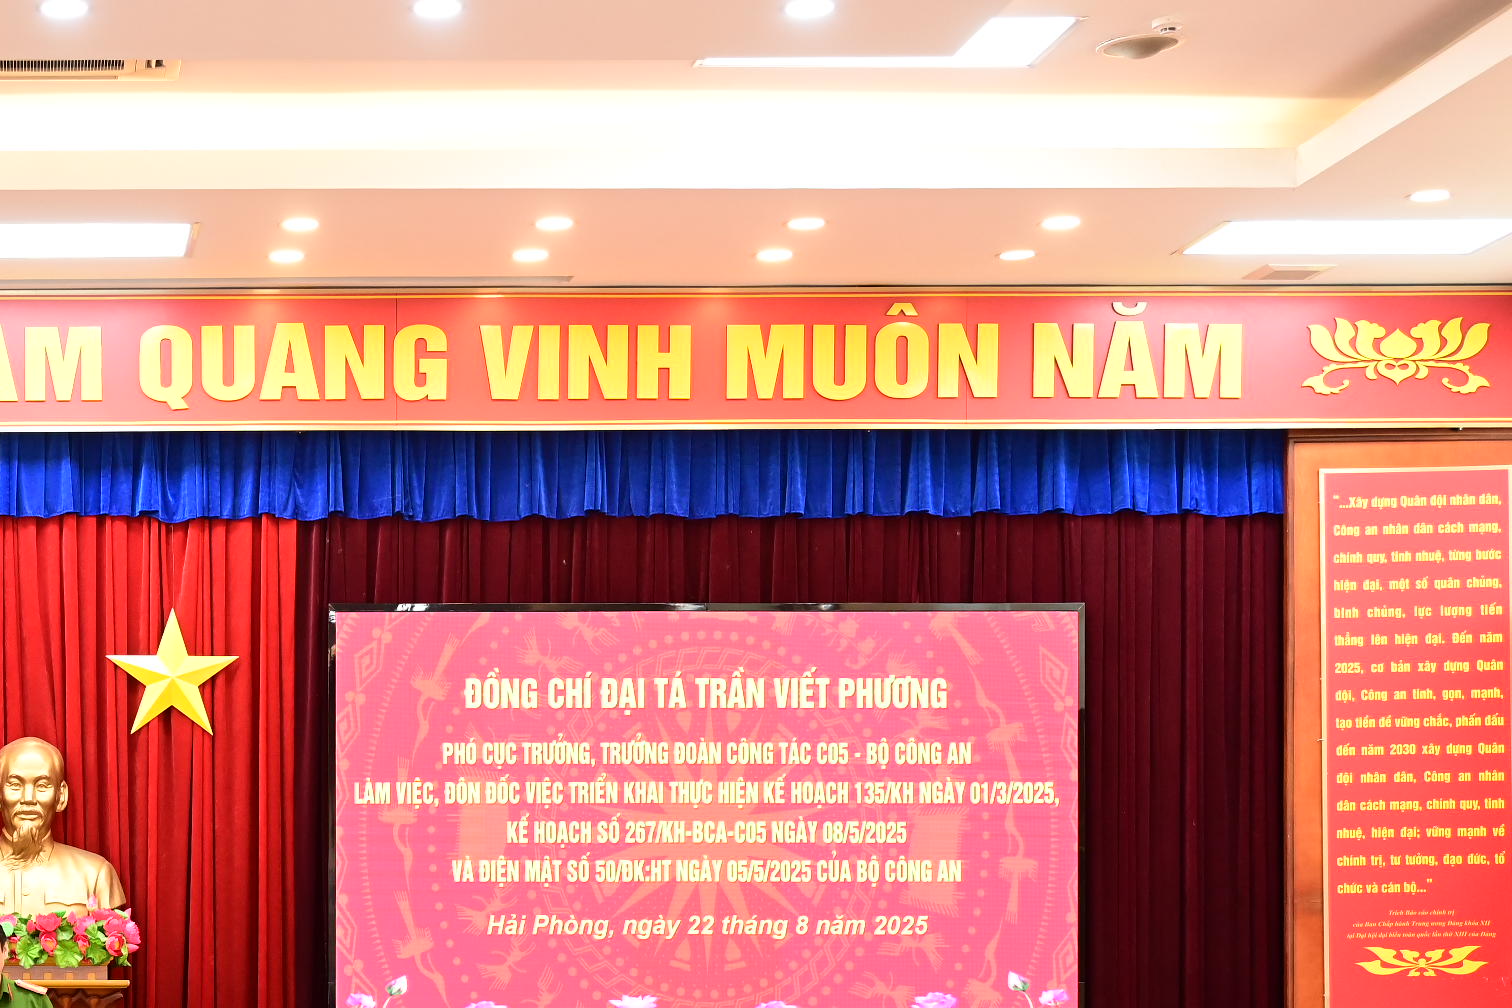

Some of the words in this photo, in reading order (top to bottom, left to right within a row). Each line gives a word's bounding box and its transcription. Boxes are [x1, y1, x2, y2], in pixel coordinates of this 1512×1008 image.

[139, 322, 448, 410] QUANG
[479, 324, 691, 400] VINH
[726, 302, 999, 400] MUÔN
[1032, 301, 1243, 399] NĂM
[464, 668, 537, 709] ĐỒNG
[548, 672, 592, 708] CHÍ
[600, 678, 644, 715] ĐẠI
[654, 671, 686, 708] TÁ
[695, 667, 764, 708] TRẦN
[774, 667, 830, 708] VIẾT
[839, 675, 947, 708] PHƯƠNG
[443, 738, 476, 764] PHÓ
[482, 742, 516, 769] CỤC
[522, 733, 595, 767] TRƯỞNG,
[600, 733, 668, 764] TRƯỞNG
[674, 738, 721, 764] ĐOÀN
[727, 738, 773, 764] CÔNG
[779, 738, 811, 764] TÁC
[817, 742, 848, 764] C05
[866, 738, 889, 769] BỘ
[895, 738, 941, 764] CÔNG
[947, 742, 971, 764] AN
[355, 778, 390, 804] LÀM
[396, 778, 438, 809] VIỆC,
[445, 777, 480, 804] ĐÔN
[485, 774, 520, 804] ĐỐC
[526, 777, 563, 808] VIỆC
[569, 773, 617, 803] TRIỂN
[624, 781, 663, 803] KHAI
[669, 779, 712, 808] THỰC
[718, 777, 758, 808] HIỆN
[764, 774, 786, 803] KẾ
[791, 782, 848, 808] HOẠCH
[855, 782, 913, 804] 135/KH
[919, 777, 965, 803] NGÀY
[970, 782, 1059, 806] 01/3/2025,
[507, 813, 529, 843] KẾ
[534, 821, 591, 848] HOẠCH
[597, 813, 620, 843] SỐ
[625, 821, 766, 843] 267/KH-BCA-C05
[772, 816, 817, 843] NGÀY
[823, 821, 906, 843] 08/5/2025
[452, 856, 474, 882] VÀ
[479, 856, 519, 887] ĐIỆN
[525, 856, 561, 887] MẬT
[567, 852, 590, 882] SỐ
[676, 855, 722, 882] NGÀY
[727, 860, 811, 882] 05/5/2025
[817, 851, 851, 882] CỦA
[857, 856, 879, 887] BỘ
[885, 856, 932, 882] CÔNG
[937, 860, 961, 882] AN
[488, 914, 526, 934] Hải
[533, 915, 613, 939] Phòng,
[623, 915, 681, 939] ngày
[688, 915, 714, 934] 22
[722, 915, 788, 939] tháng
[796, 916, 808, 934] 8
[816, 915, 865, 934] năm
[874, 916, 928, 935] 2025
